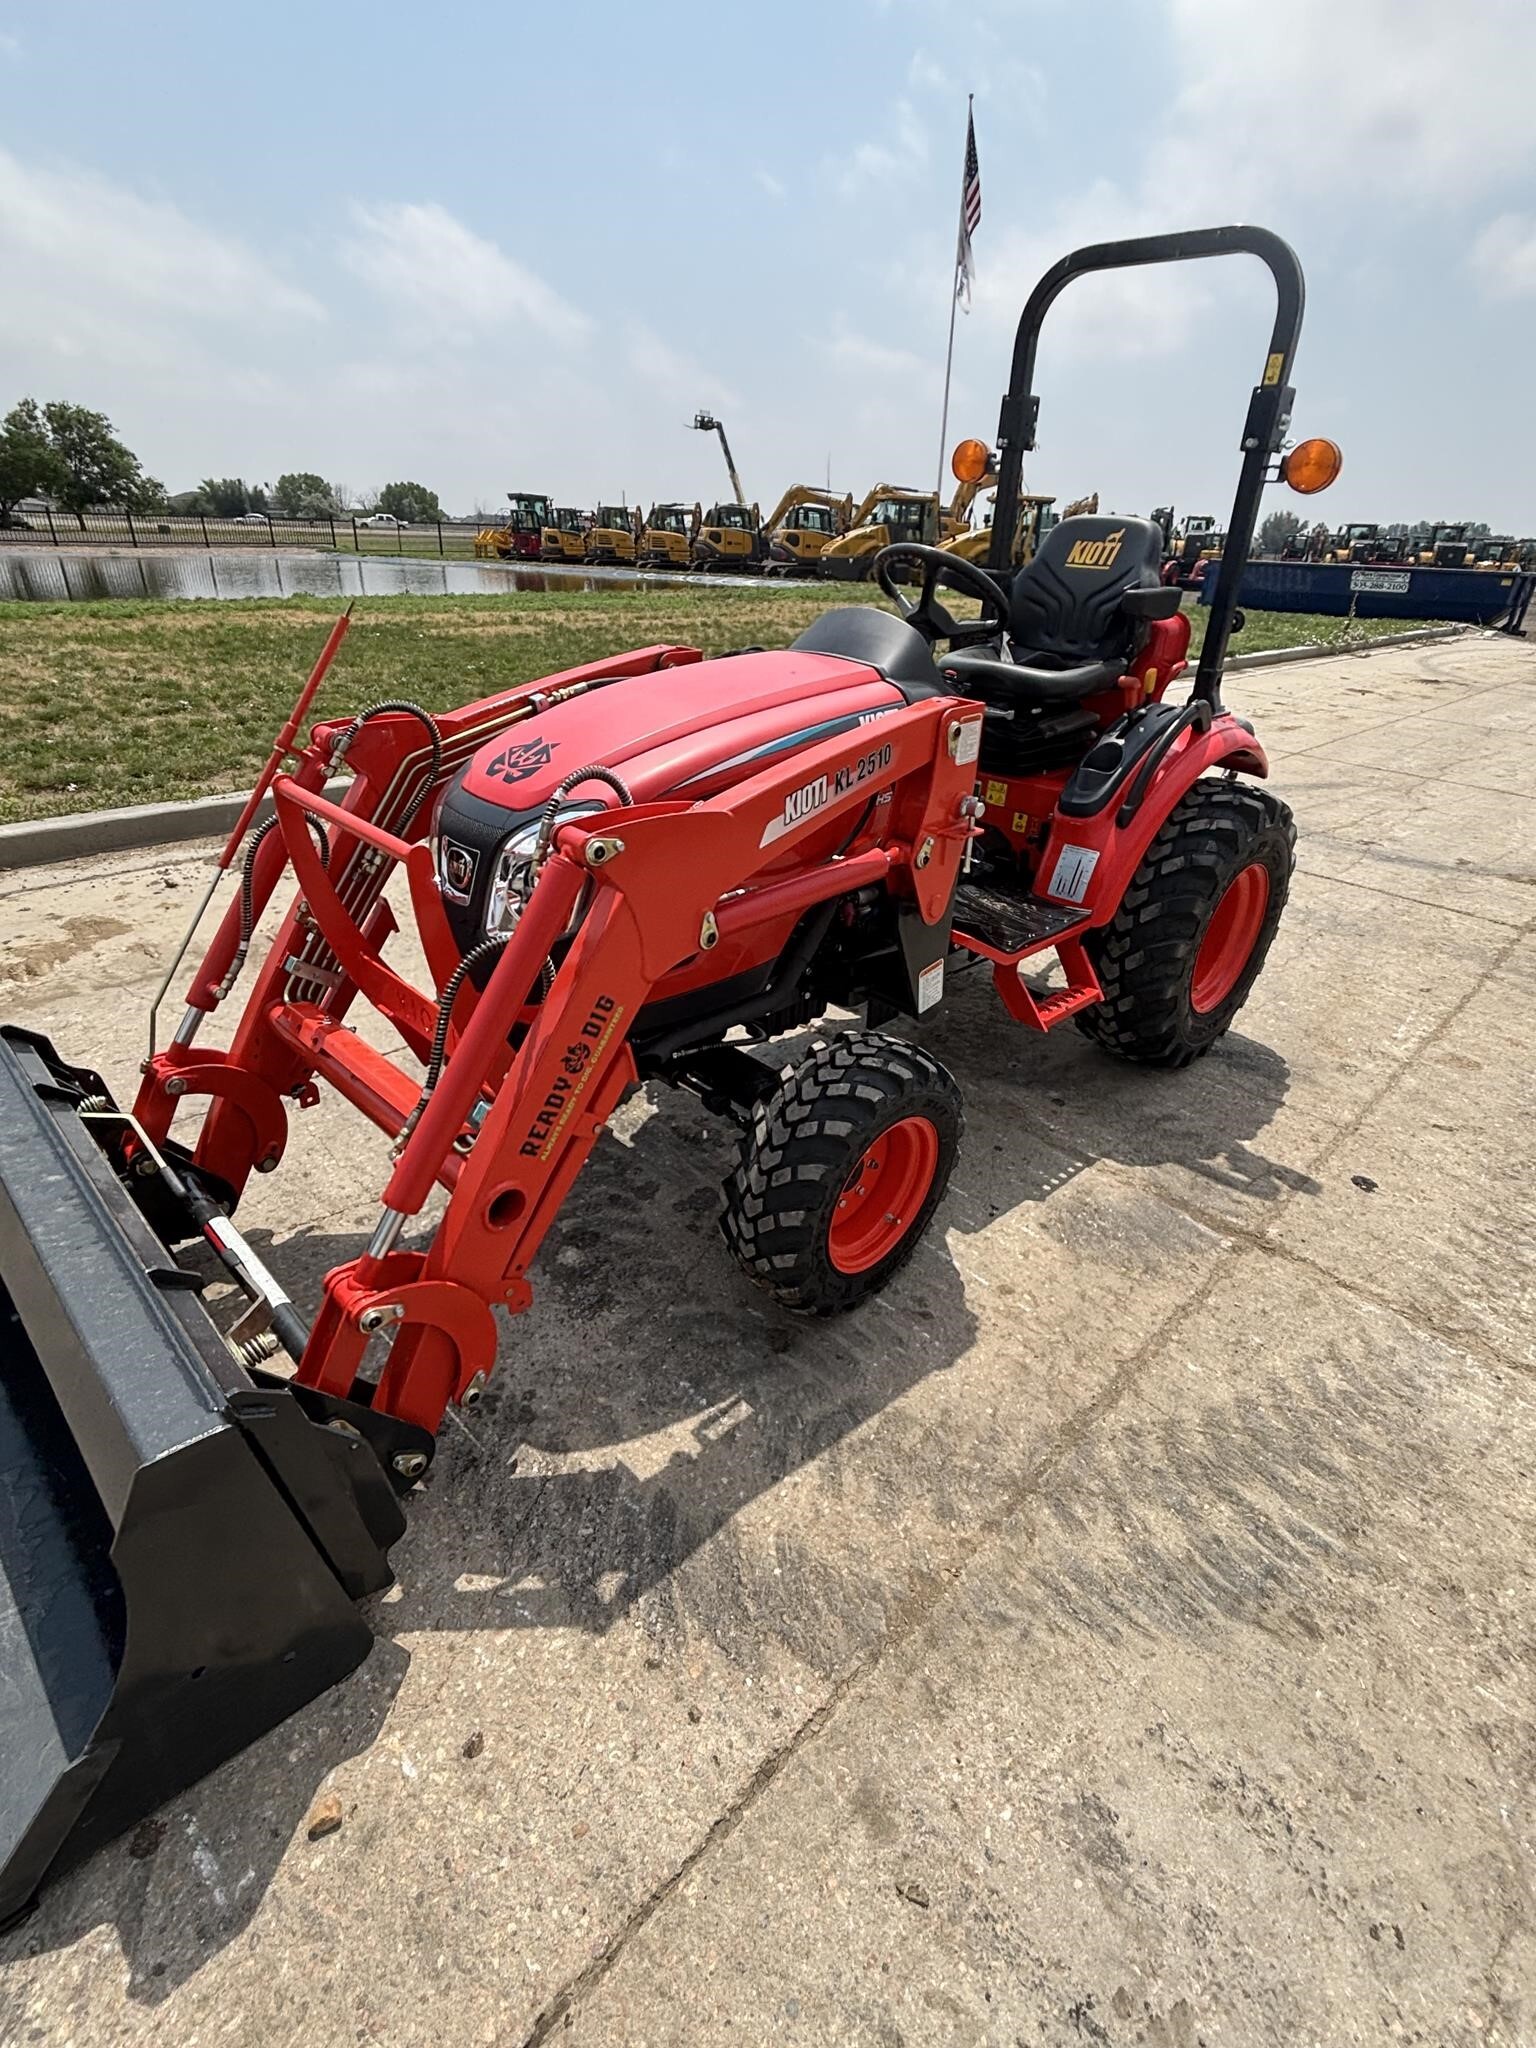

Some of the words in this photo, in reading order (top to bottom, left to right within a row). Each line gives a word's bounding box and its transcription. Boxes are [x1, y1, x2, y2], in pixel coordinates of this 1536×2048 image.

[1065, 540, 1122, 566] KIOTI
[784, 774, 828, 826] KIOTI
[835, 768, 853, 795] KL
[857, 743, 891, 781] 2510
[519, 1076, 572, 1157] READY
[581, 995, 615, 1038] DIG
[574, 1083, 584, 1095] TO
